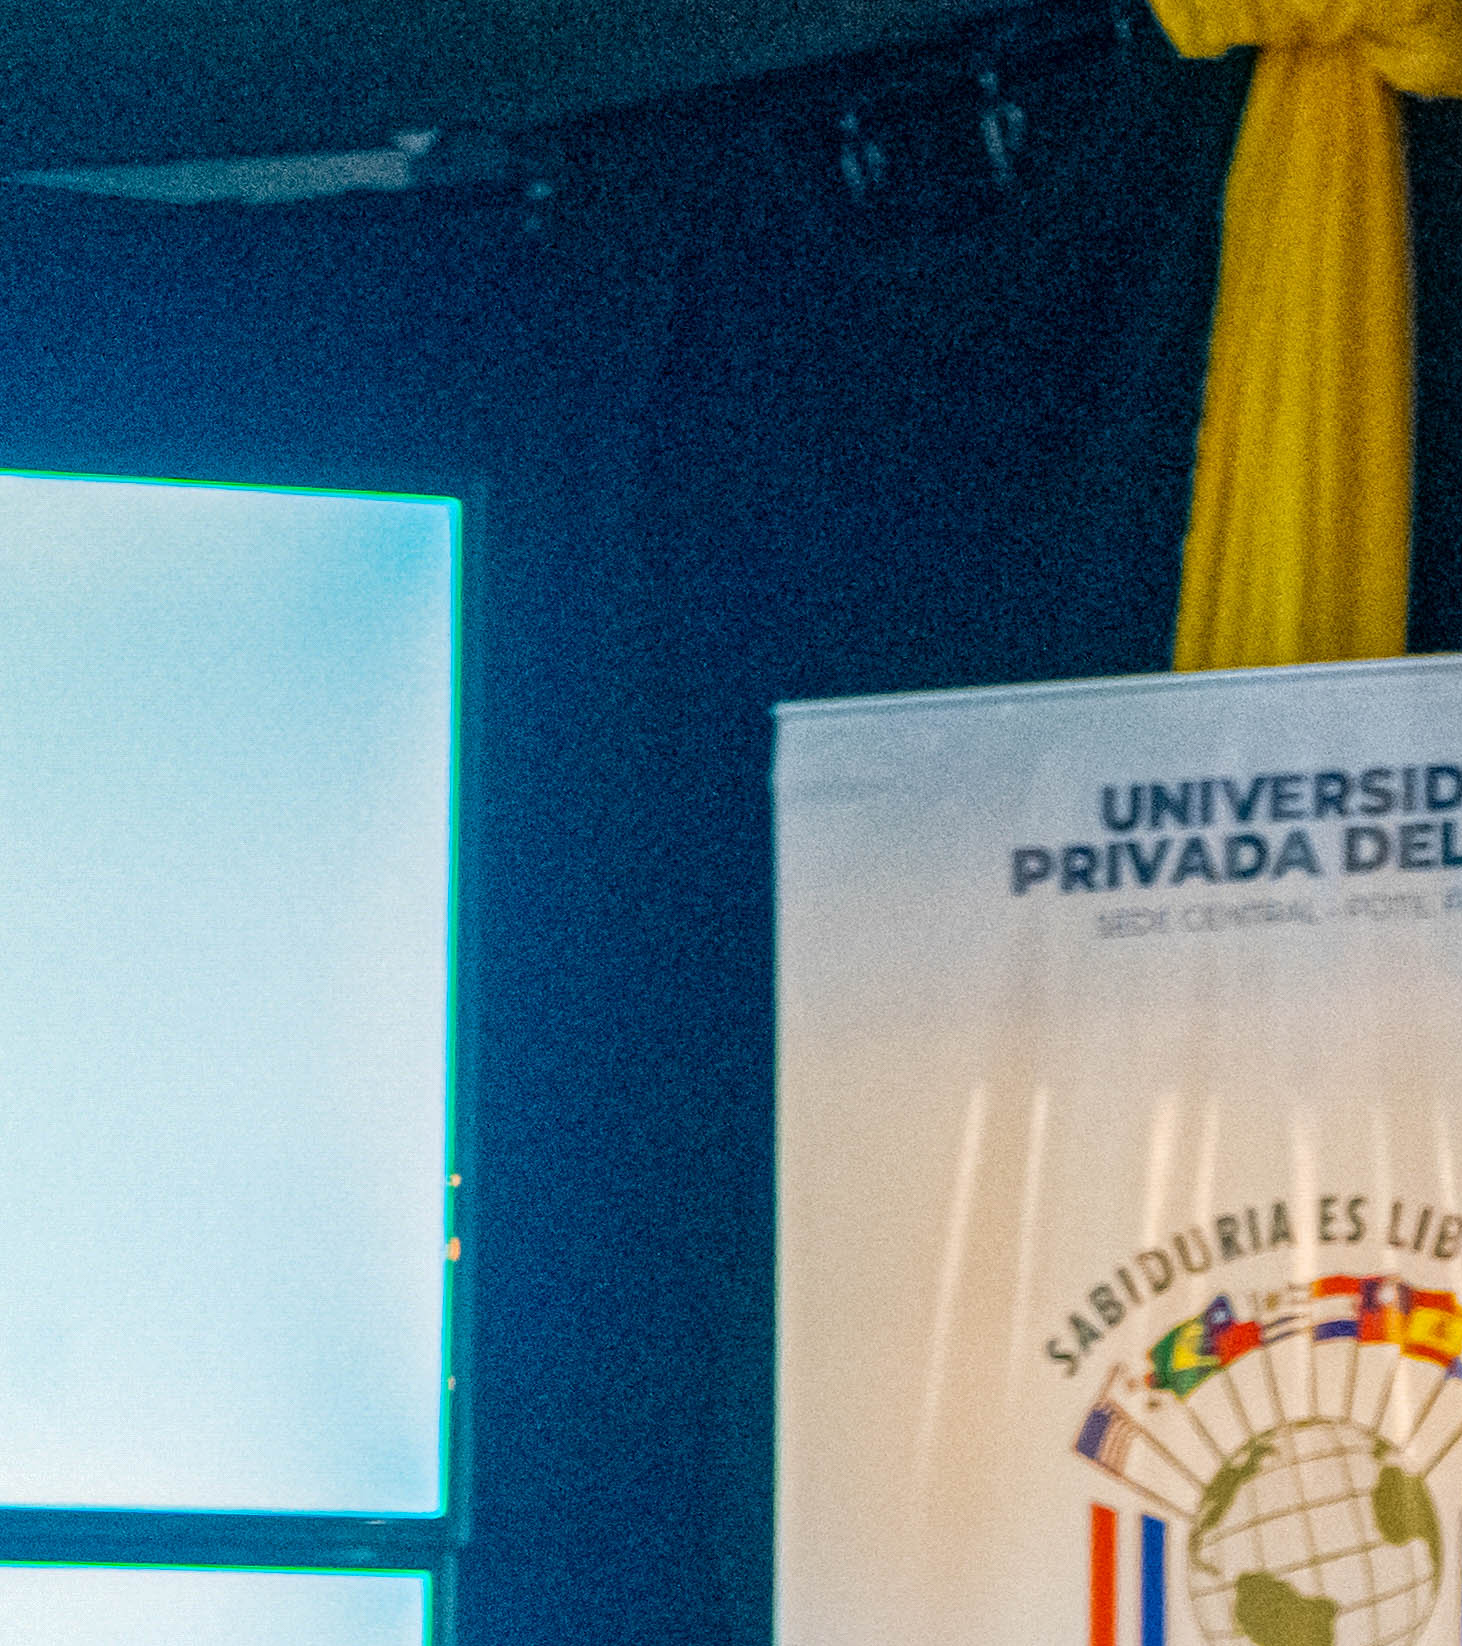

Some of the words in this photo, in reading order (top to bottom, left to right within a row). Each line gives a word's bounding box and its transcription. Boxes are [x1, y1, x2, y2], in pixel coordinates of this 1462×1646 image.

[1011, 827, 1322, 896] PRIVADA
[1045, 1197, 1296, 1378] SABIDURIA
[1317, 1195, 1368, 1244] ES
